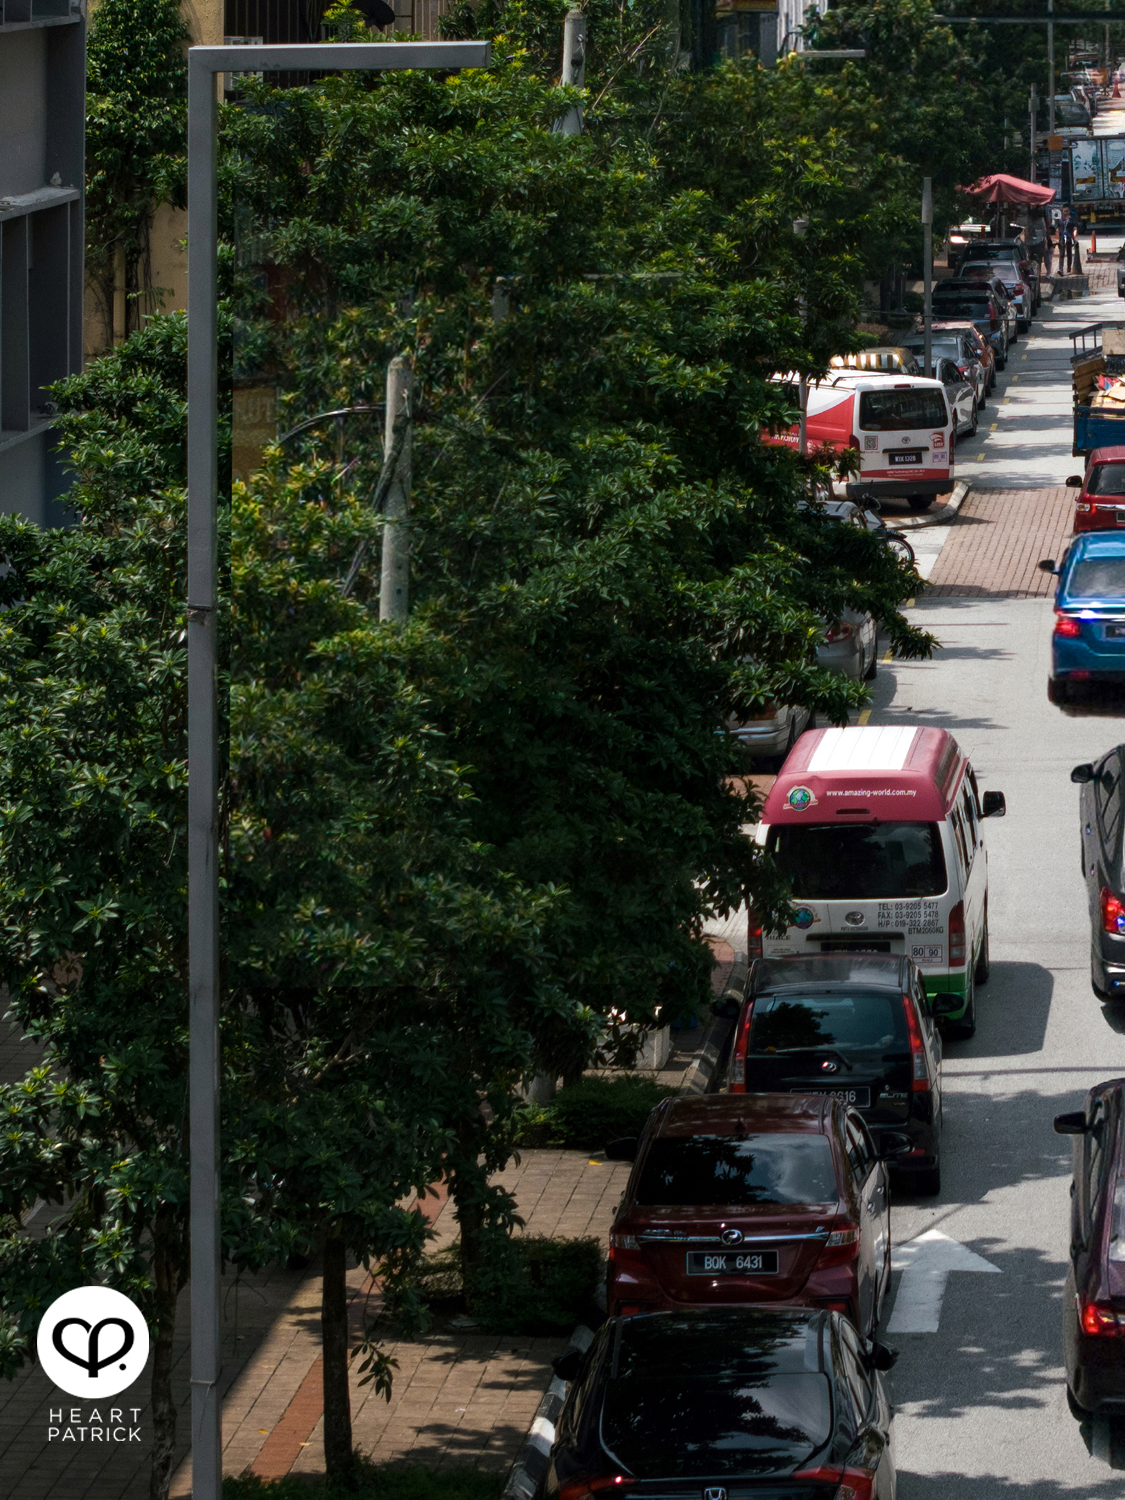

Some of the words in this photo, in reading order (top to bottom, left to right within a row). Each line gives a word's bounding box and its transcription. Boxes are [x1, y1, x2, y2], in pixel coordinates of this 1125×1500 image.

[826, 789, 917, 797] www.amazing-world.com.my
[878, 903, 892, 911] TEL:
[895, 902, 921, 910] 03-9205
[924, 902, 938, 910] 5477
[878, 911, 893, 919] FAX:
[895, 911, 921, 919] 03-9205
[924, 910, 939, 918] 5478
[913, 947, 924, 956] 80
[928, 948, 938, 956] 90
[736, 1255, 763, 1269] 6431
